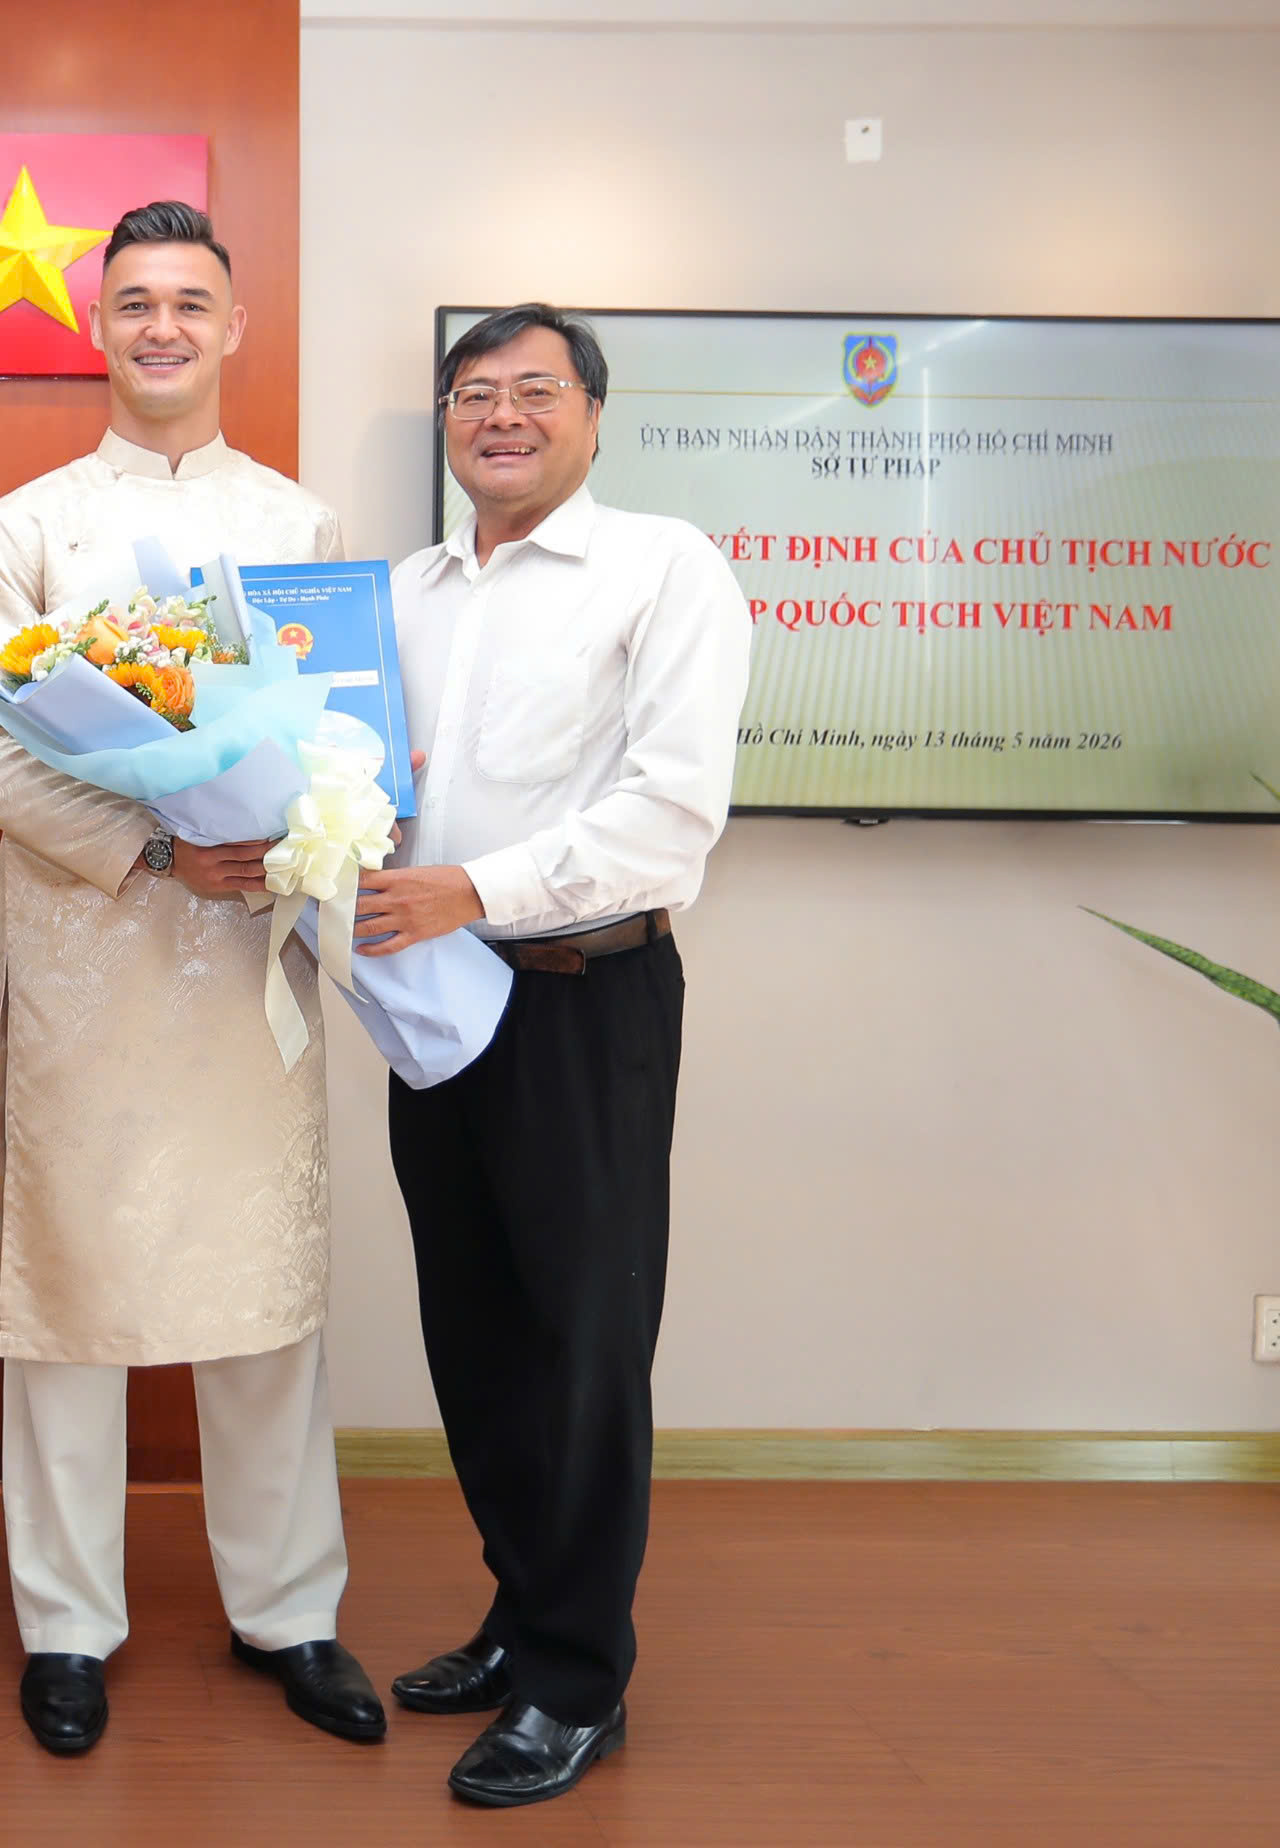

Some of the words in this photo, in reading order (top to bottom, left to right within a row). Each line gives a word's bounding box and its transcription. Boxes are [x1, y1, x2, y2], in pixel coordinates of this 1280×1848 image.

[676, 428, 721, 449] BAN
[847, 427, 921, 451] THÀNH
[1012, 428, 1049, 453] CHÍ
[1055, 432, 1114, 454] MINH
[846, 456, 878, 477] TƯ
[786, 535, 878, 569] ĐỊNH
[889, 529, 965, 564] CỦA
[973, 531, 1051, 566] CHỦ
[1062, 539, 1151, 573] TỊCH
[1163, 533, 1271, 568] NƯỚC
[775, 592, 881, 631] QUỐC
[892, 601, 981, 635] TỊCH
[993, 598, 1079, 636] VIỆT
[1088, 604, 1174, 631] NAM
[808, 728, 865, 749] Minh,
[871, 730, 917, 751] ngày
[924, 731, 945, 747] 13
[951, 730, 1006, 751] tháng
[1012, 731, 1024, 749] 5
[1029, 732, 1071, 750] năm
[1077, 732, 1123, 750] 2026
